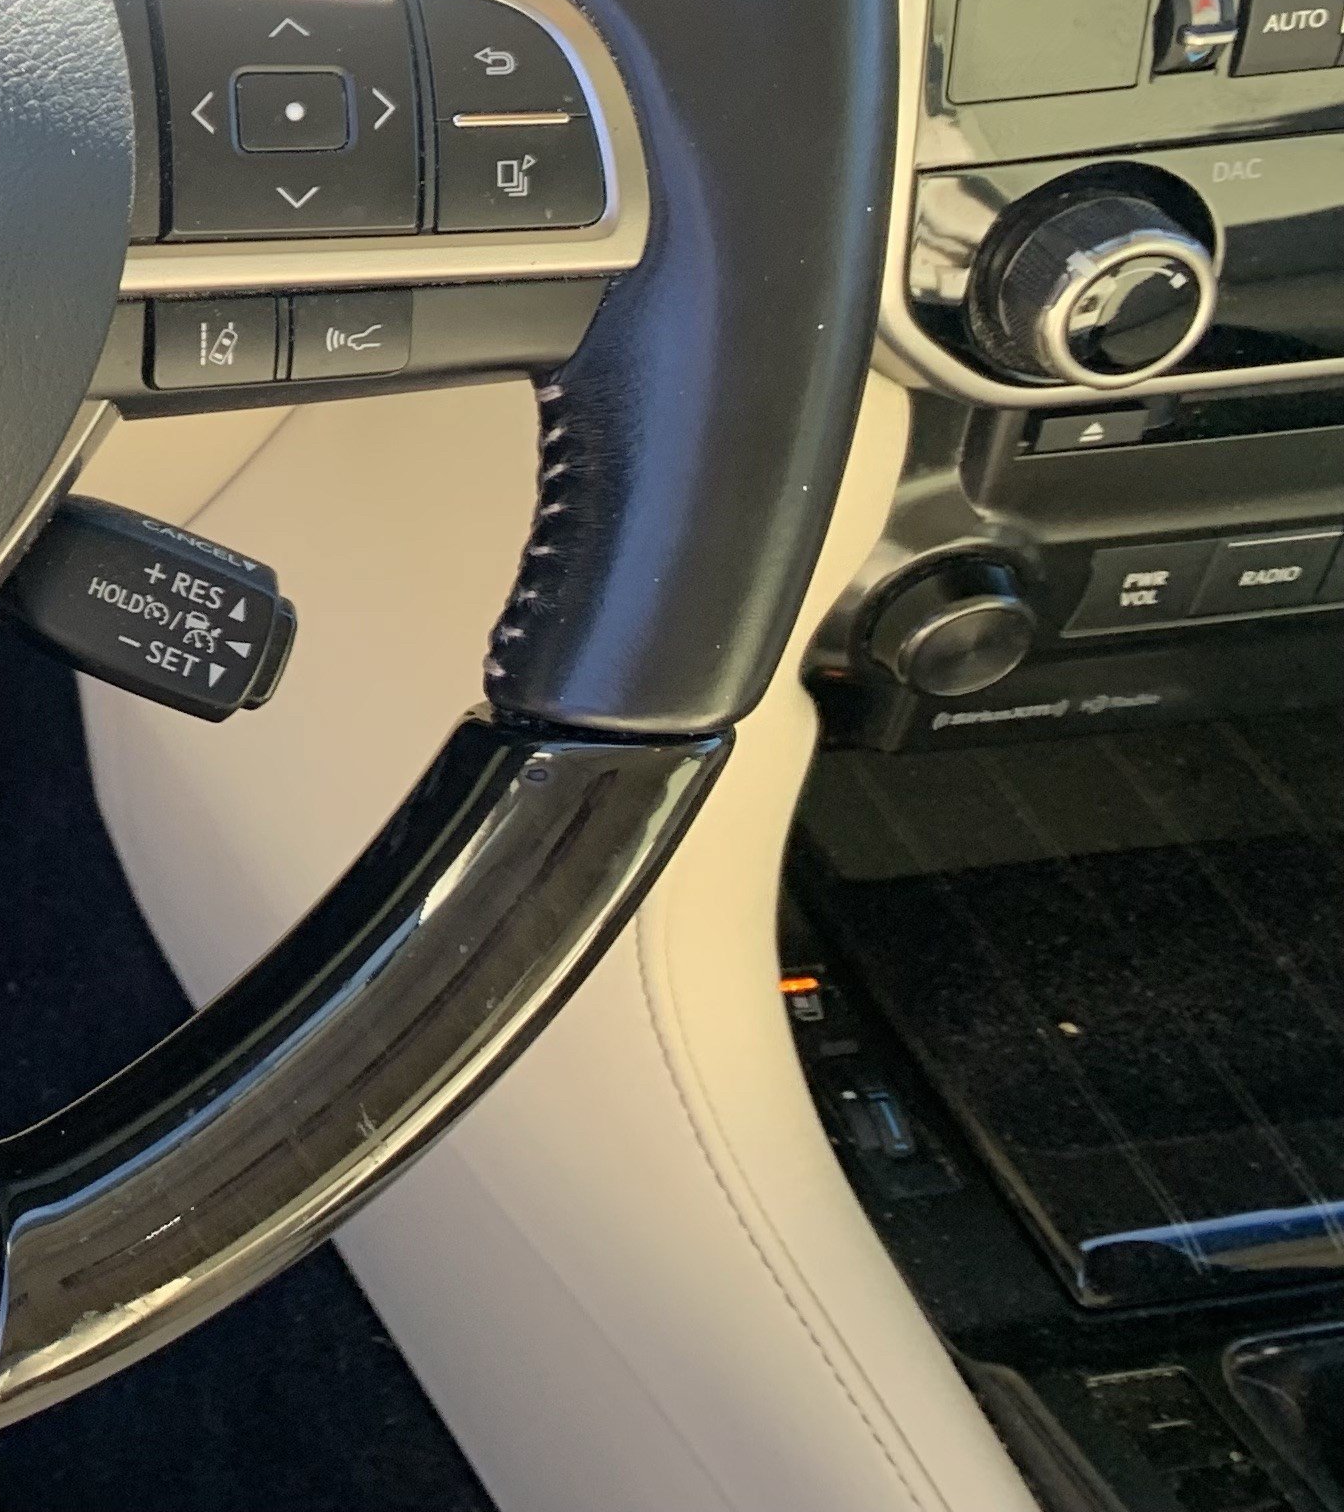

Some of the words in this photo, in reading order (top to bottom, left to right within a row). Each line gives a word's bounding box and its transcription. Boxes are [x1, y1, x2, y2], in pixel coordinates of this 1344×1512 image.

[1262, 7, 1331, 35] AUTO
[1213, 156, 1263, 184] DAC
[141, 519, 242, 569] CANCEL
[1122, 570, 1170, 589] PWR
[1238, 565, 1303, 587] RADIO
[87, 576, 145, 615] HOLD
[170, 571, 226, 610] RES
[1120, 589, 1160, 607] VOL
[144, 640, 202, 678] SET
